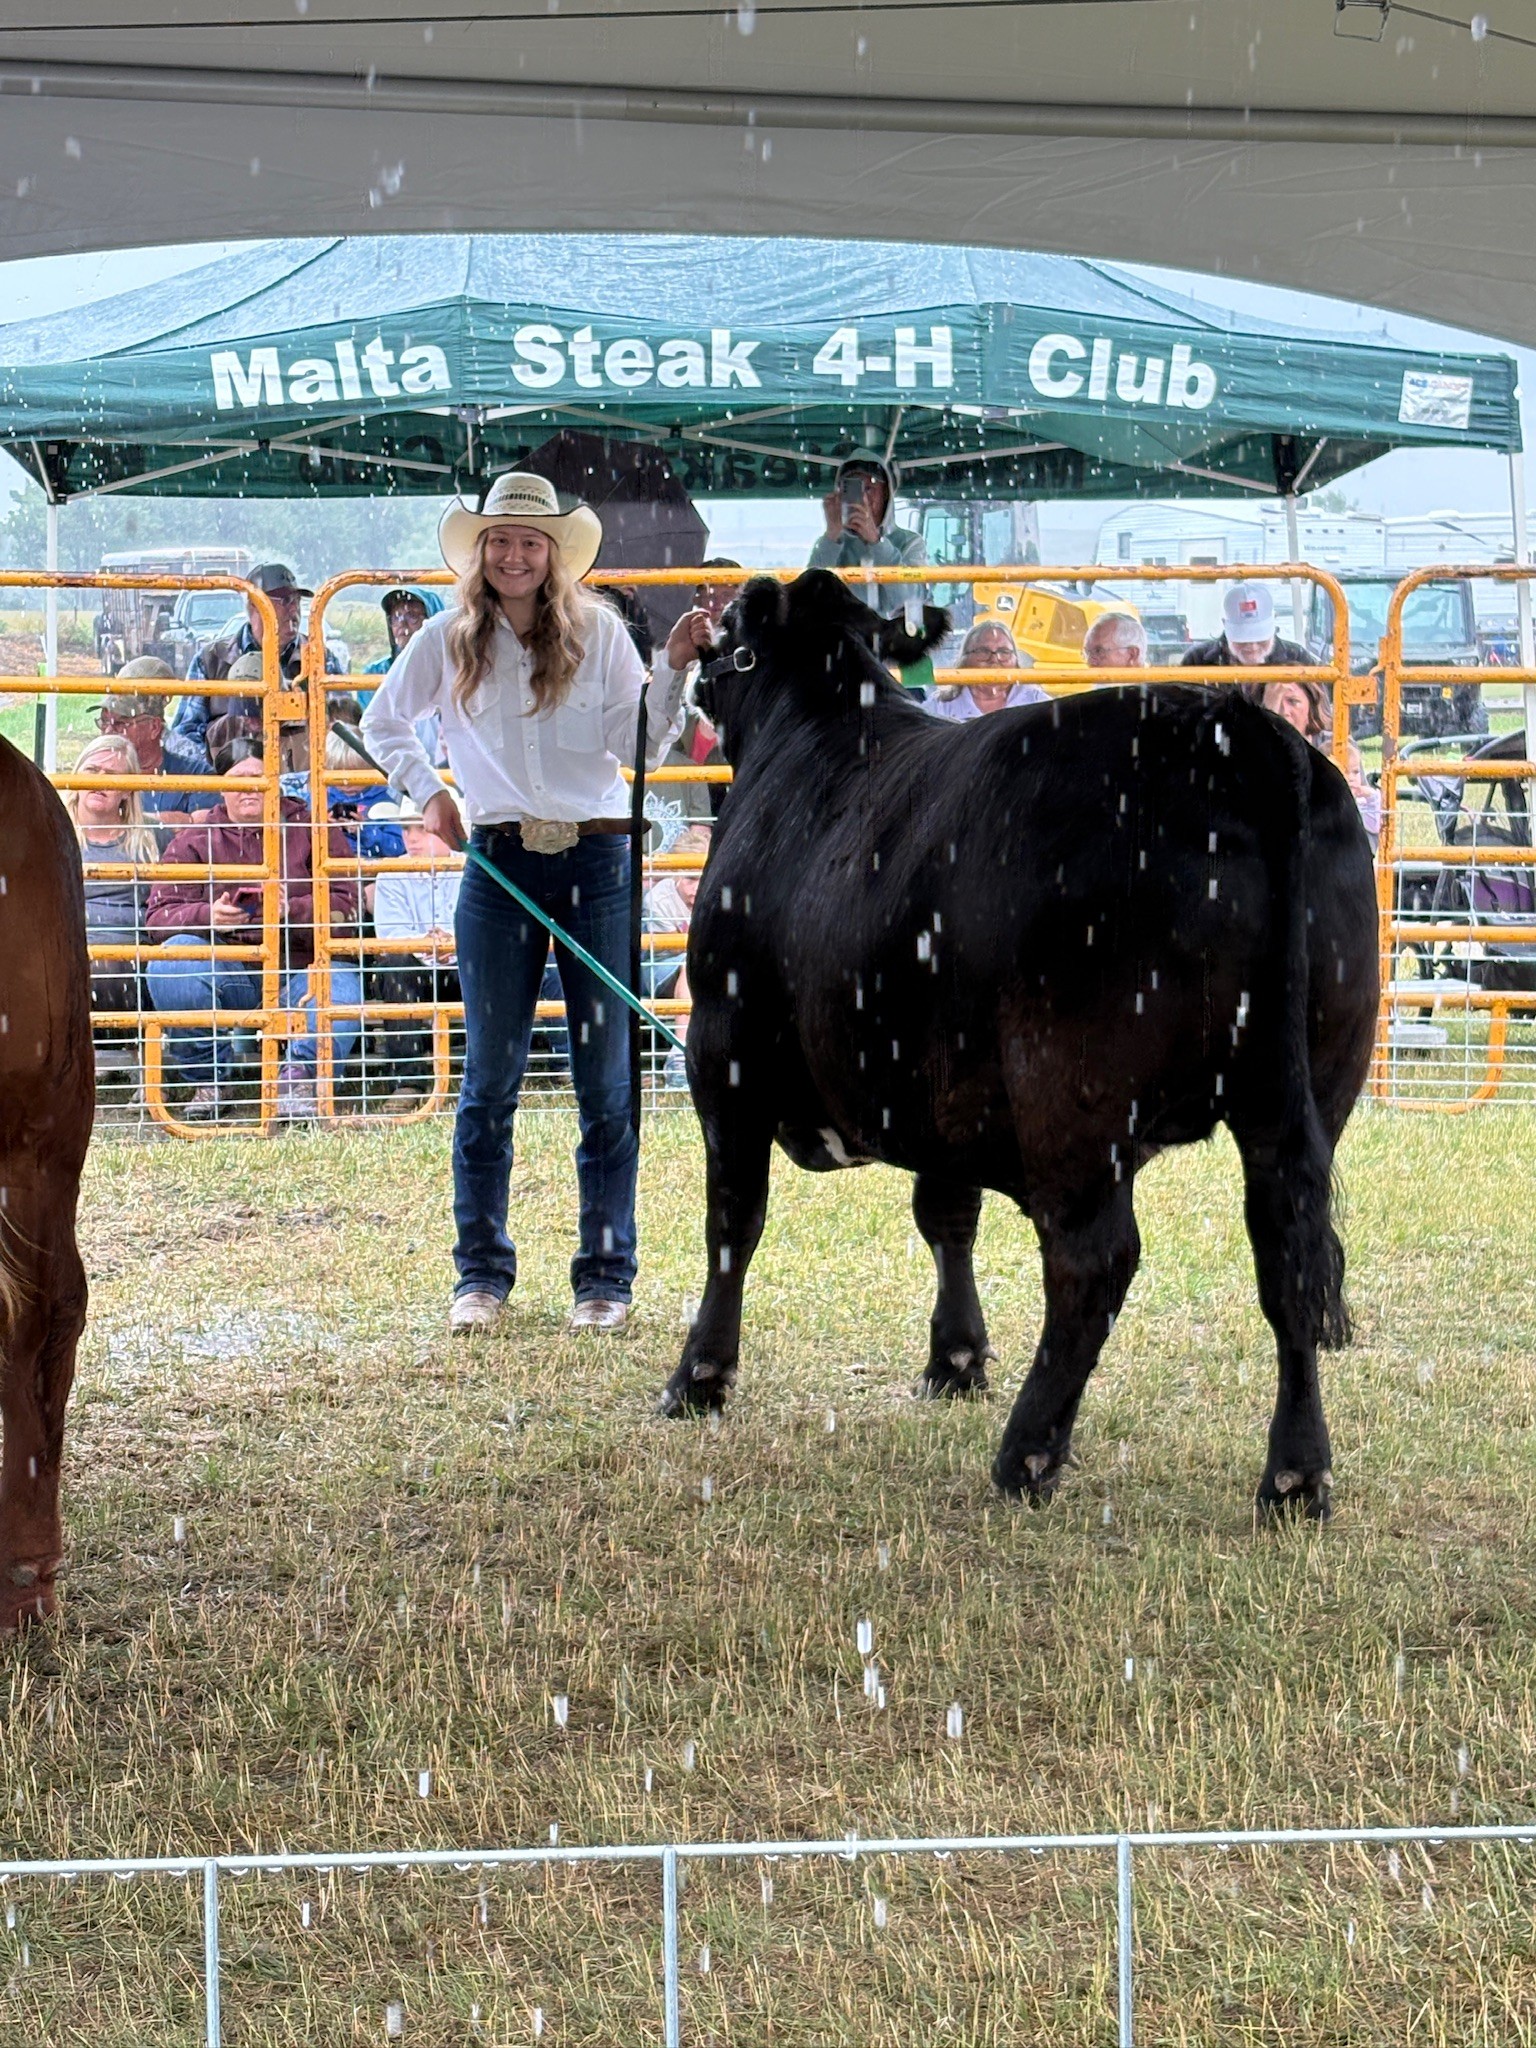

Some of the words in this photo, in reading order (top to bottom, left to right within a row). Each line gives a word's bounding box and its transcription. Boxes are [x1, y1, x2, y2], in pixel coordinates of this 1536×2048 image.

[210, 336, 452, 410] Malta
[510, 324, 763, 388] Steak
[812, 325, 954, 388] 4-H
[1028, 333, 1217, 409] Club
